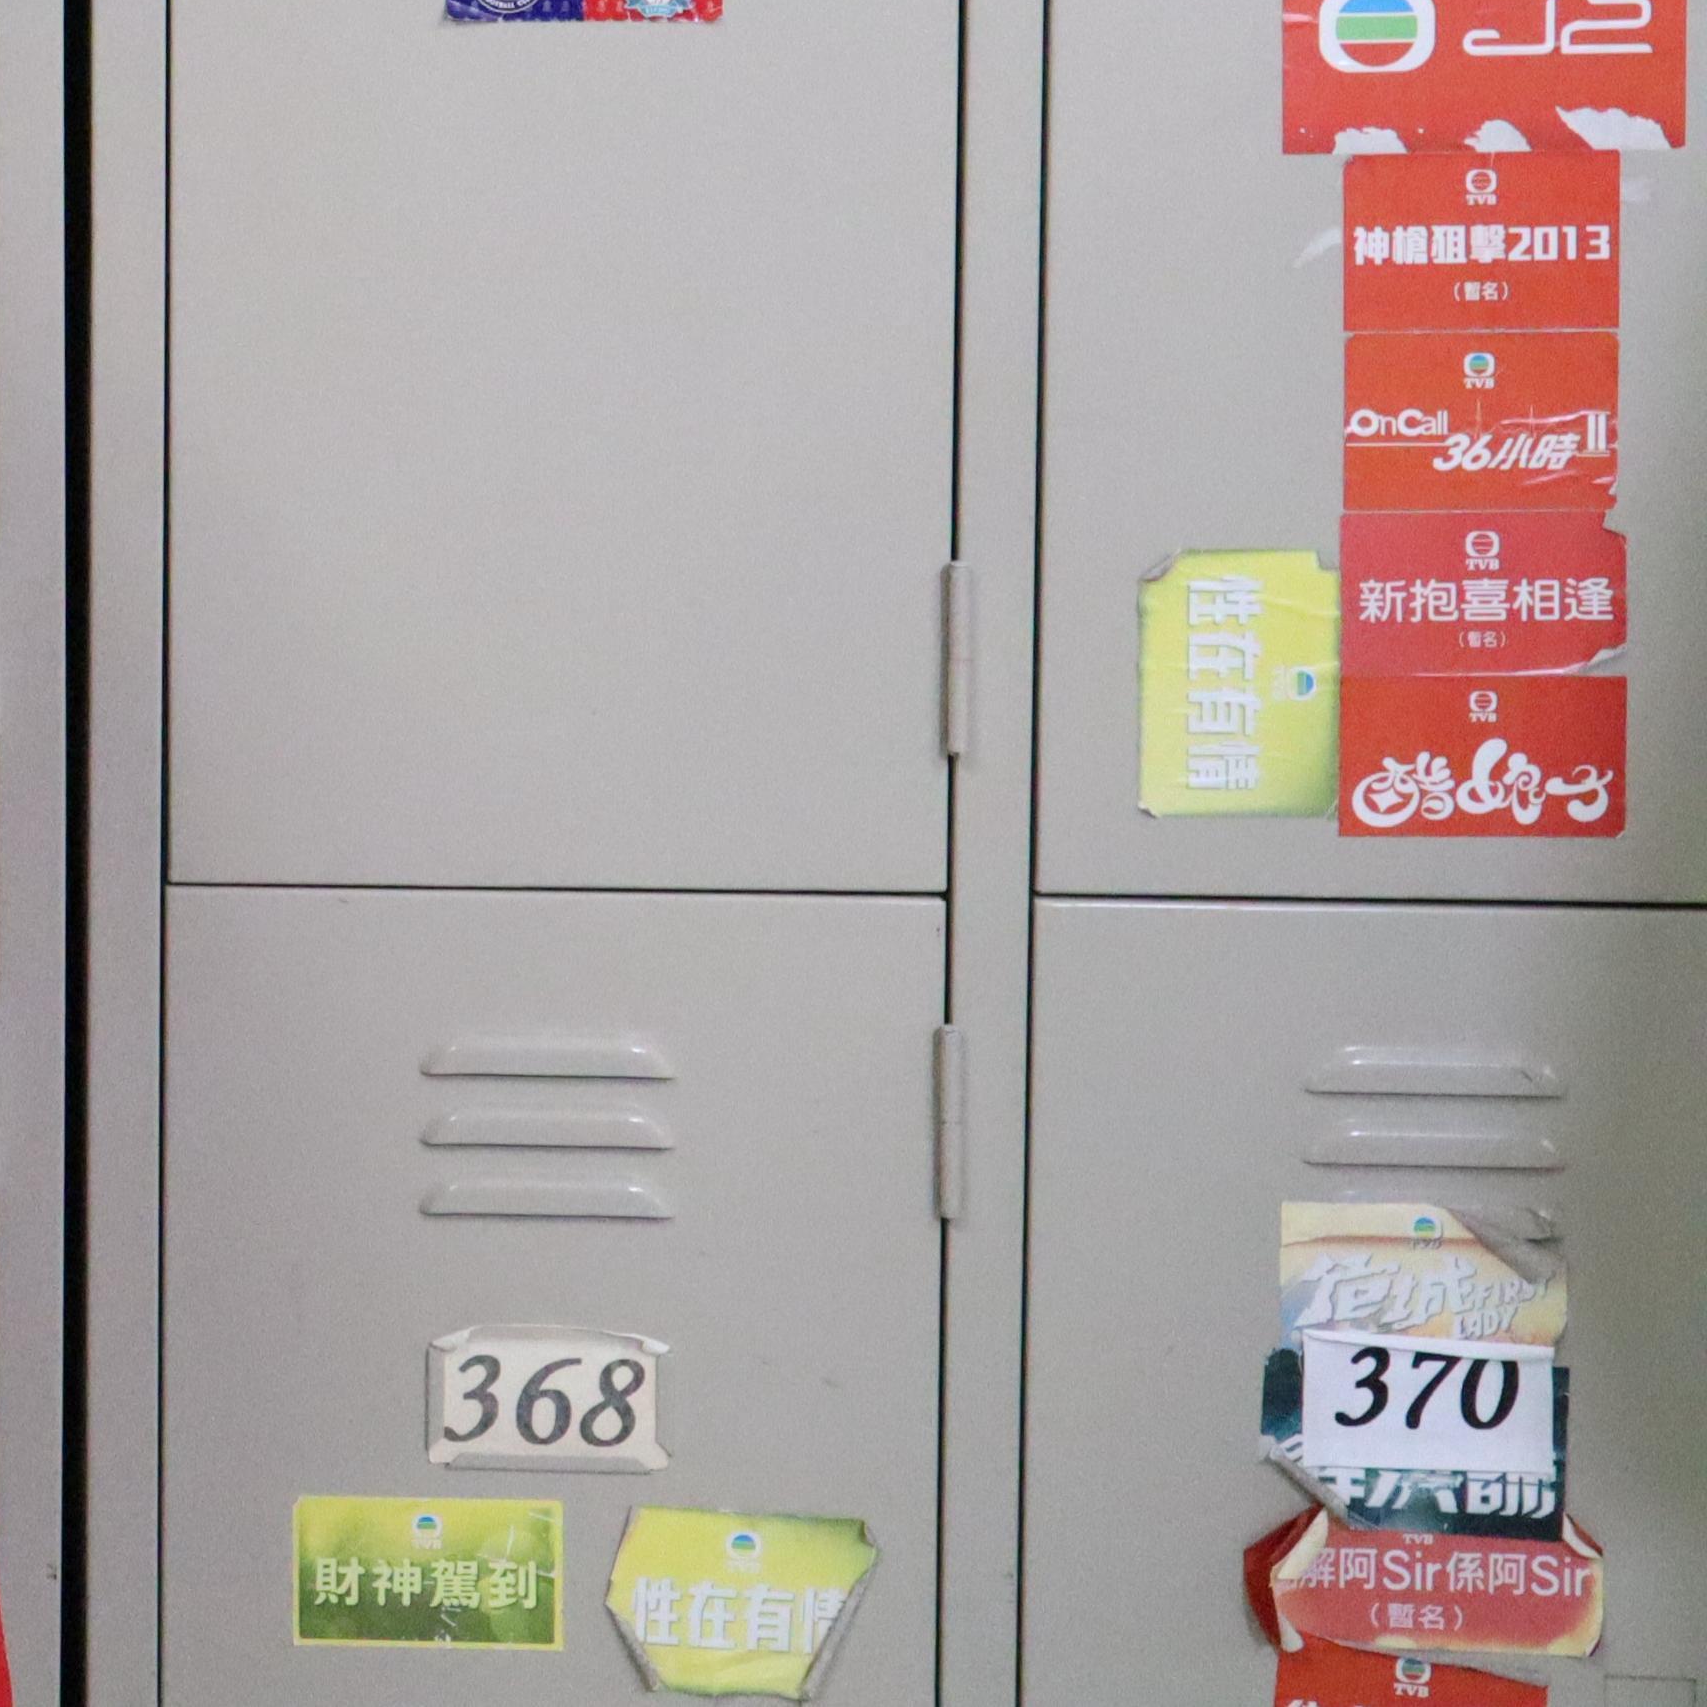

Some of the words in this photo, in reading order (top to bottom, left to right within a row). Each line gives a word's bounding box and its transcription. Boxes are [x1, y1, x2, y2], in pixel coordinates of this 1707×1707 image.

[1466, 195, 1497, 206] TVB
[1353, 224, 1611, 266] 神槍狙擊2013
[1464, 378, 1495, 389] TVB
[1433, 431, 1582, 472] 36小時
[1465, 558, 1500, 571] TVB
[1358, 578, 1615, 624] 新抱喜相逢
[1188, 576, 1266, 791] 性在有情
[1470, 712, 1498, 723] TVB
[1453, 1305, 1518, 1341] LADY
[444, 1354, 645, 1448] 368
[1334, 1346, 1520, 1431] 370
[412, 1539, 442, 1550] TVB
[1403, 1533, 1434, 1545] TVB
[313, 1558, 538, 1612] 財神駕到
[1290, 1548, 1591, 1598] 解阿Sir係阿Sir
[1370, 1603, 1465, 1630] (暫名)
[1394, 1683, 1429, 1698] TVB
